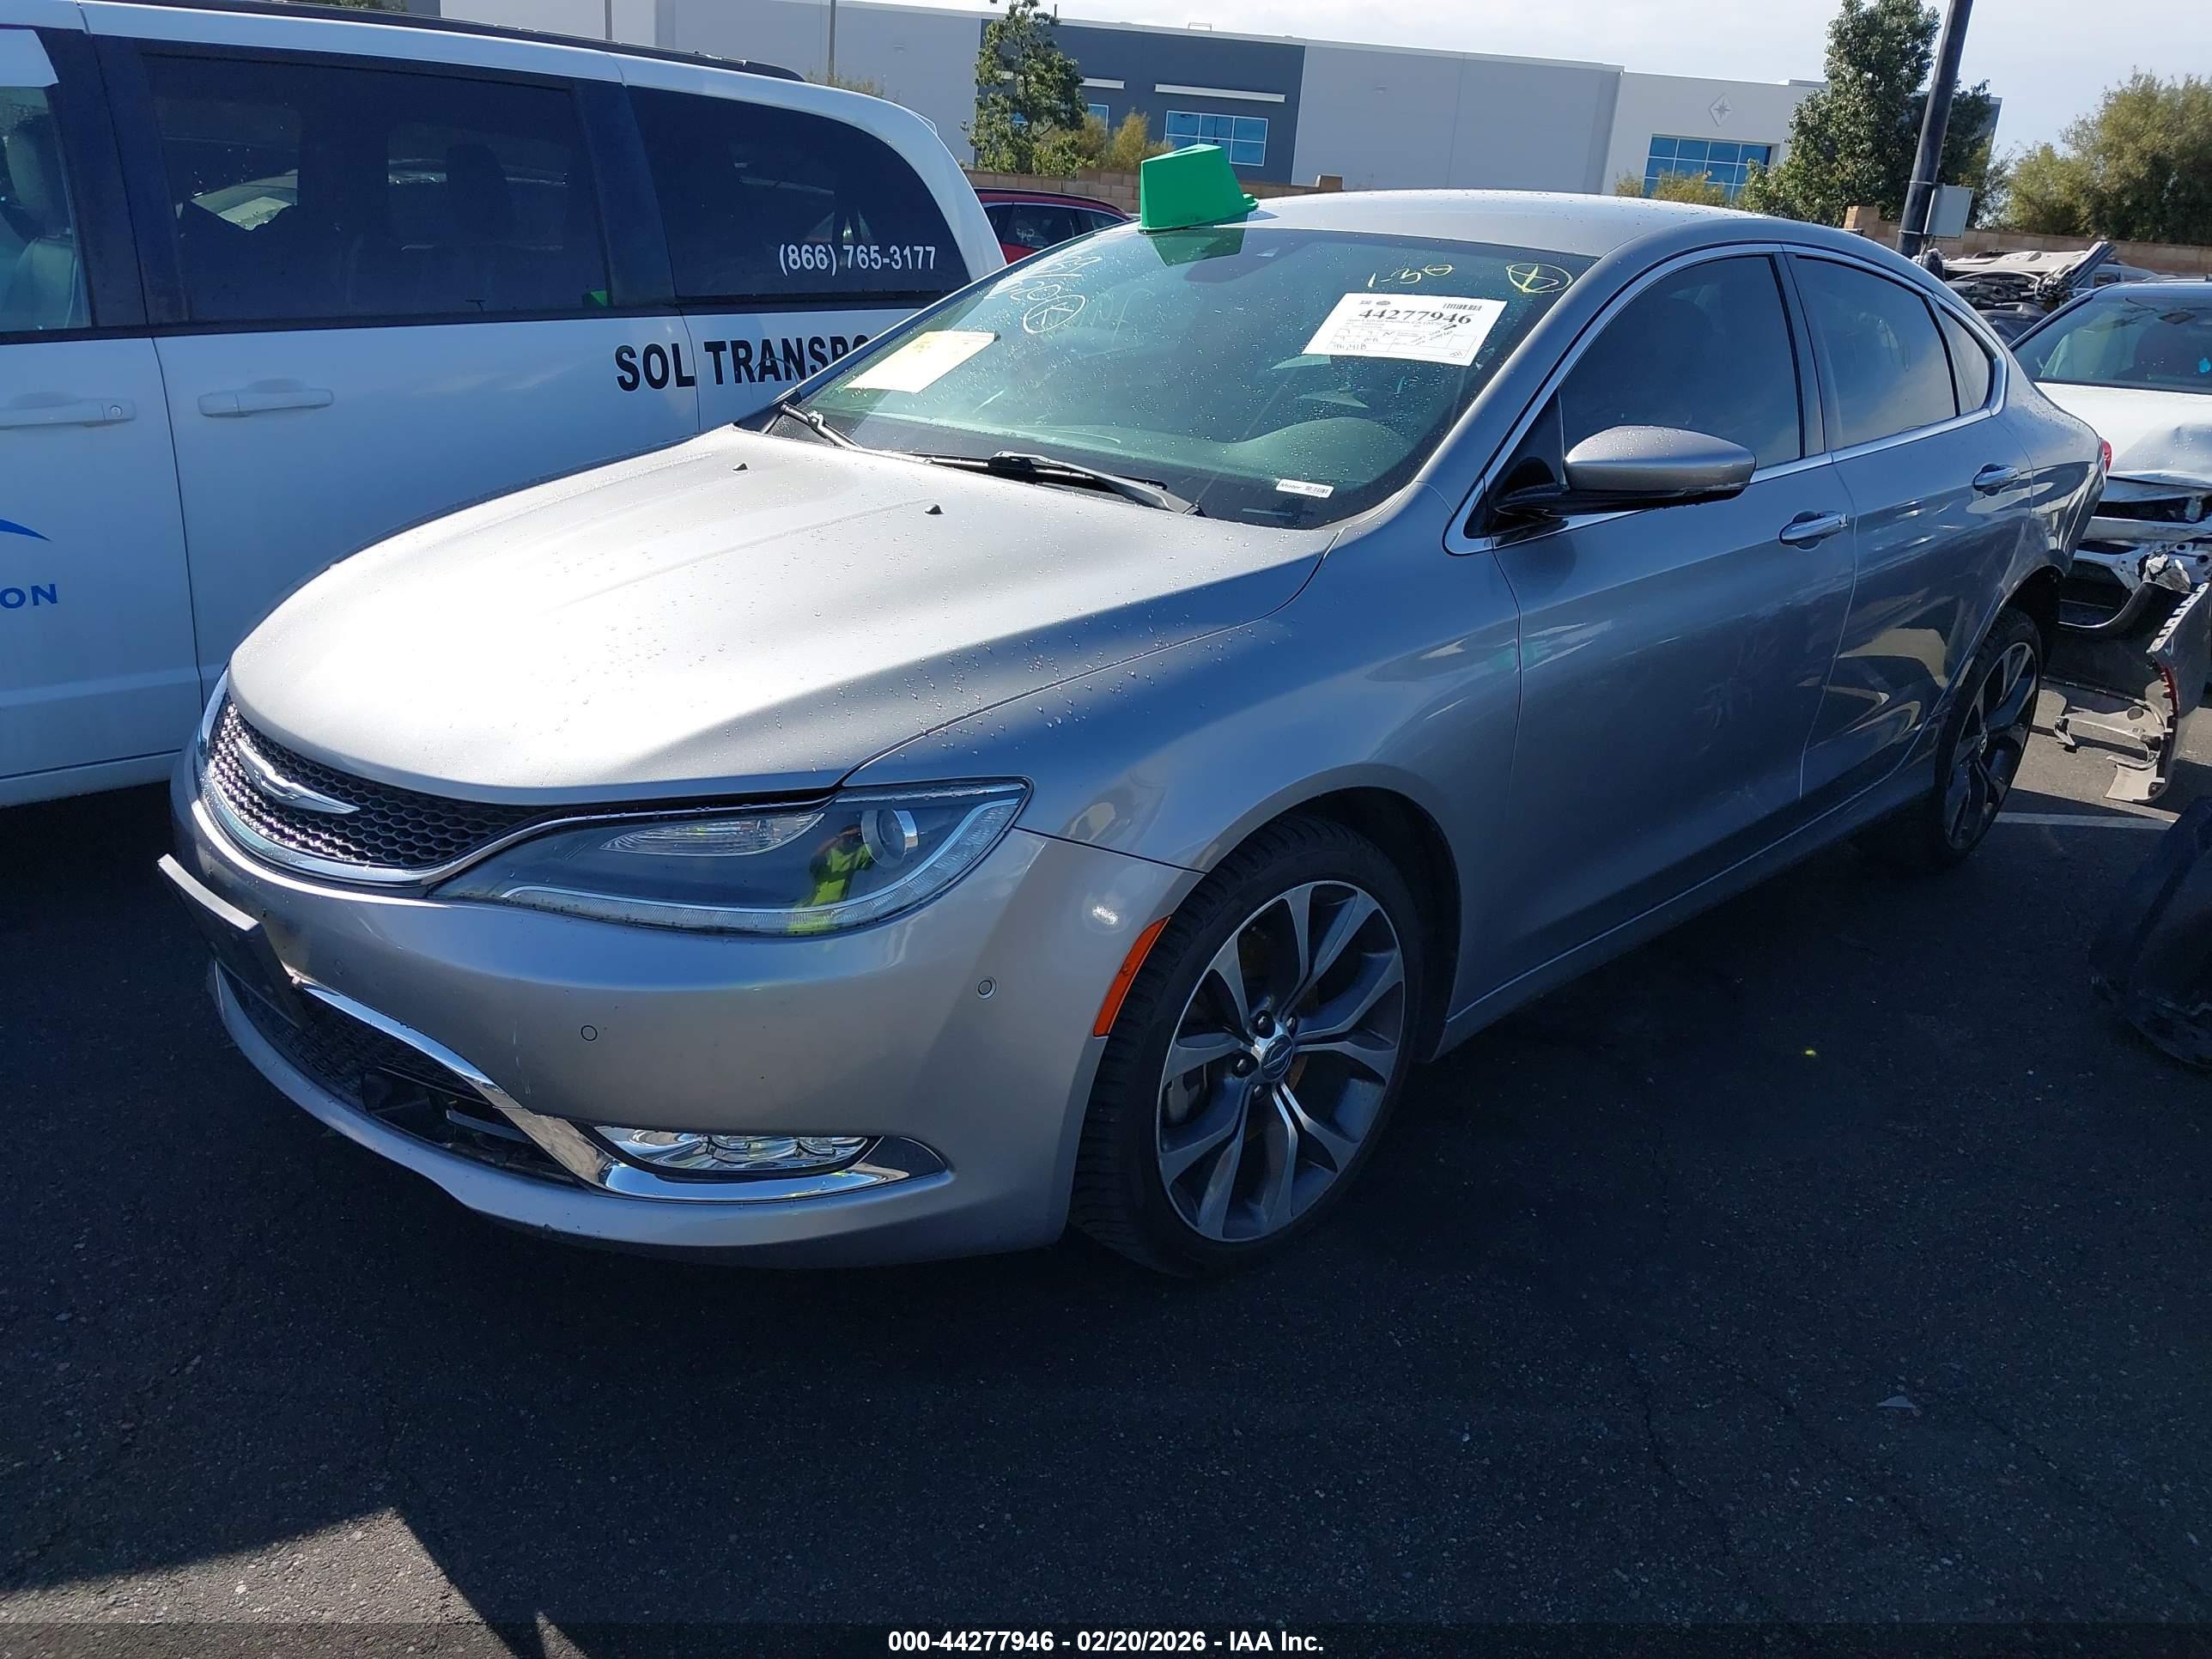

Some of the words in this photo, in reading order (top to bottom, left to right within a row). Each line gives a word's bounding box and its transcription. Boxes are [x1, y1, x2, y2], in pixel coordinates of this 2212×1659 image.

[779, 244, 837, 276] (866)
[843, 245, 936, 270] 765-3177
[1358, 308, 1476, 325] 44277946
[615, 343, 696, 392] SOL
